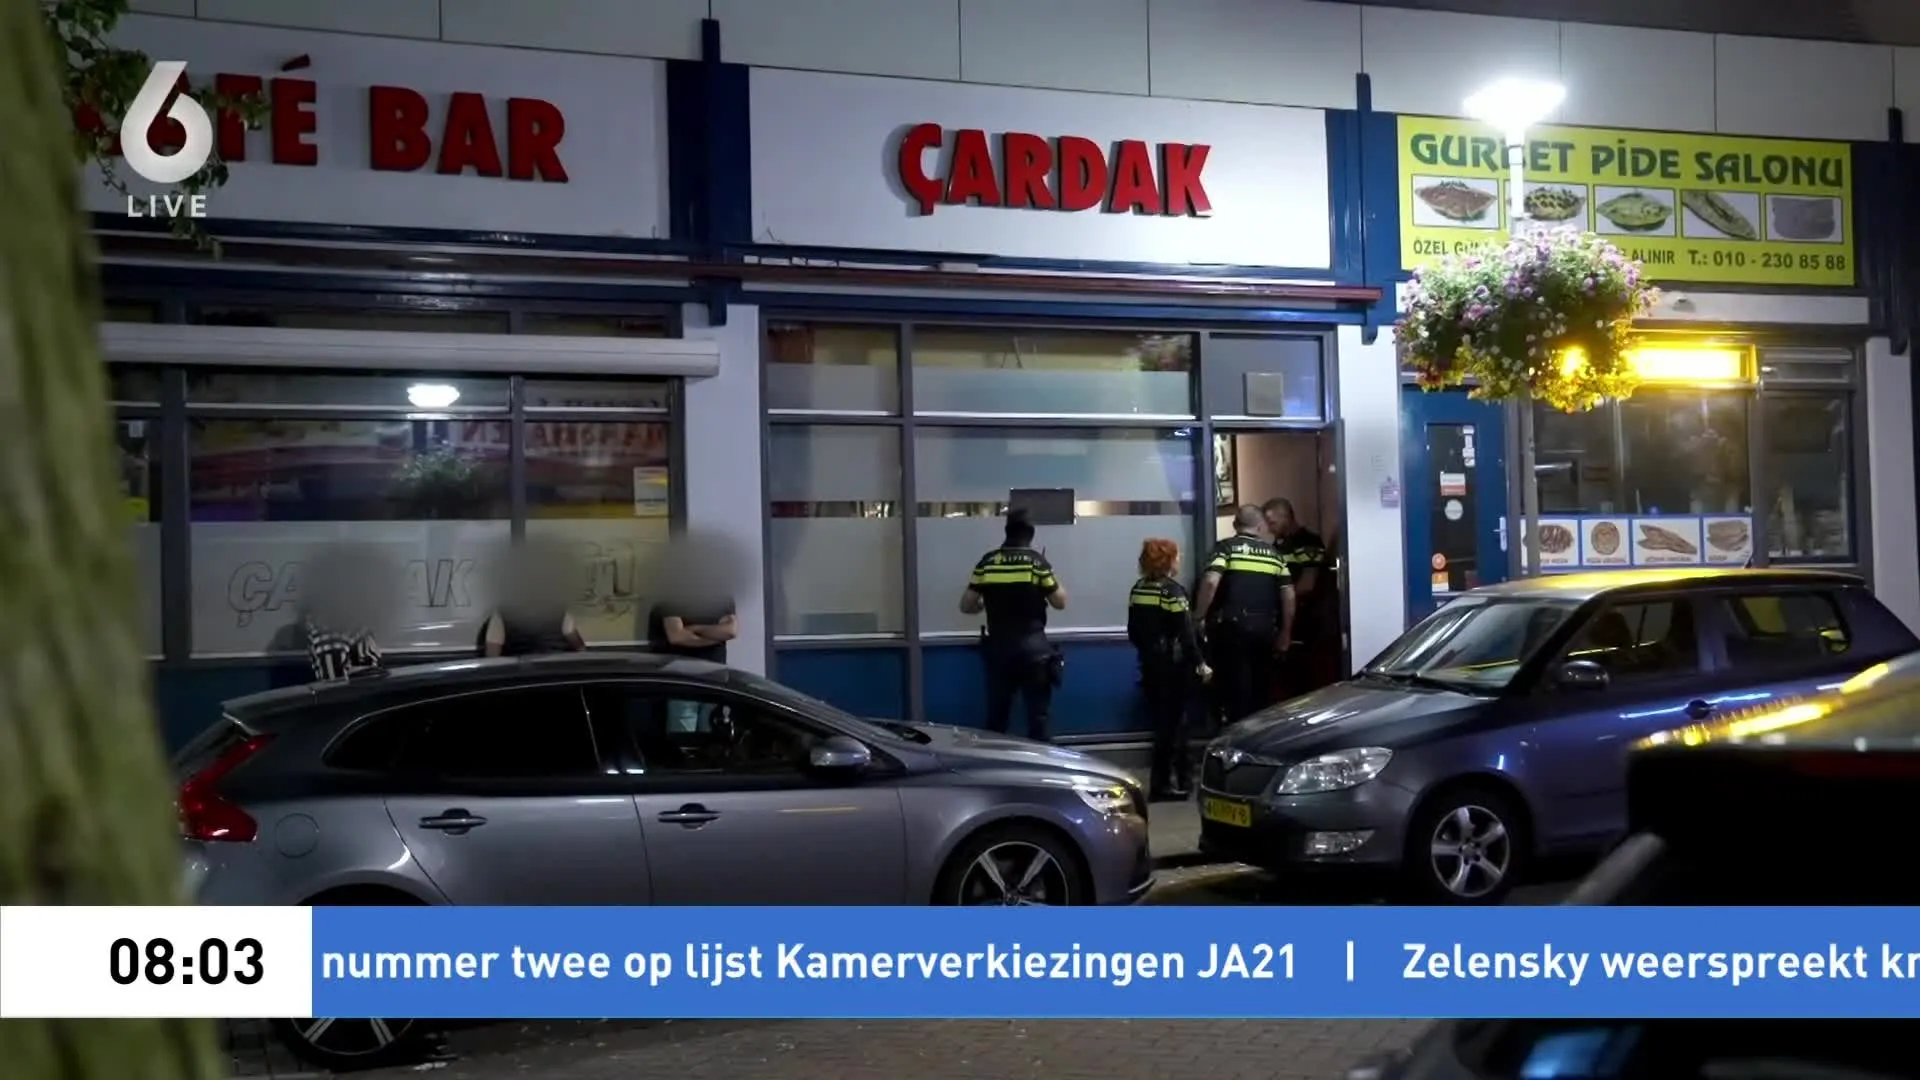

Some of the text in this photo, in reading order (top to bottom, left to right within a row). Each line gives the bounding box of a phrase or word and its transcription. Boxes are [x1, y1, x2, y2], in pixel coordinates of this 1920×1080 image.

[75, 54, 569, 183] FÉ BAR
[899, 122, 1213, 217] ÇARDAK
[1591, 139, 1681, 179] PİDE
[1694, 152, 1844, 188] SALONU
[1631, 248, 1675, 265] ALINIR
[1713, 250, 1746, 268] 010
[1762, 252, 1793, 269] 230
[1800, 254, 1820, 270] 85
[1825, 254, 1846, 271] 88
[227, 558, 475, 629] ÇAAK
